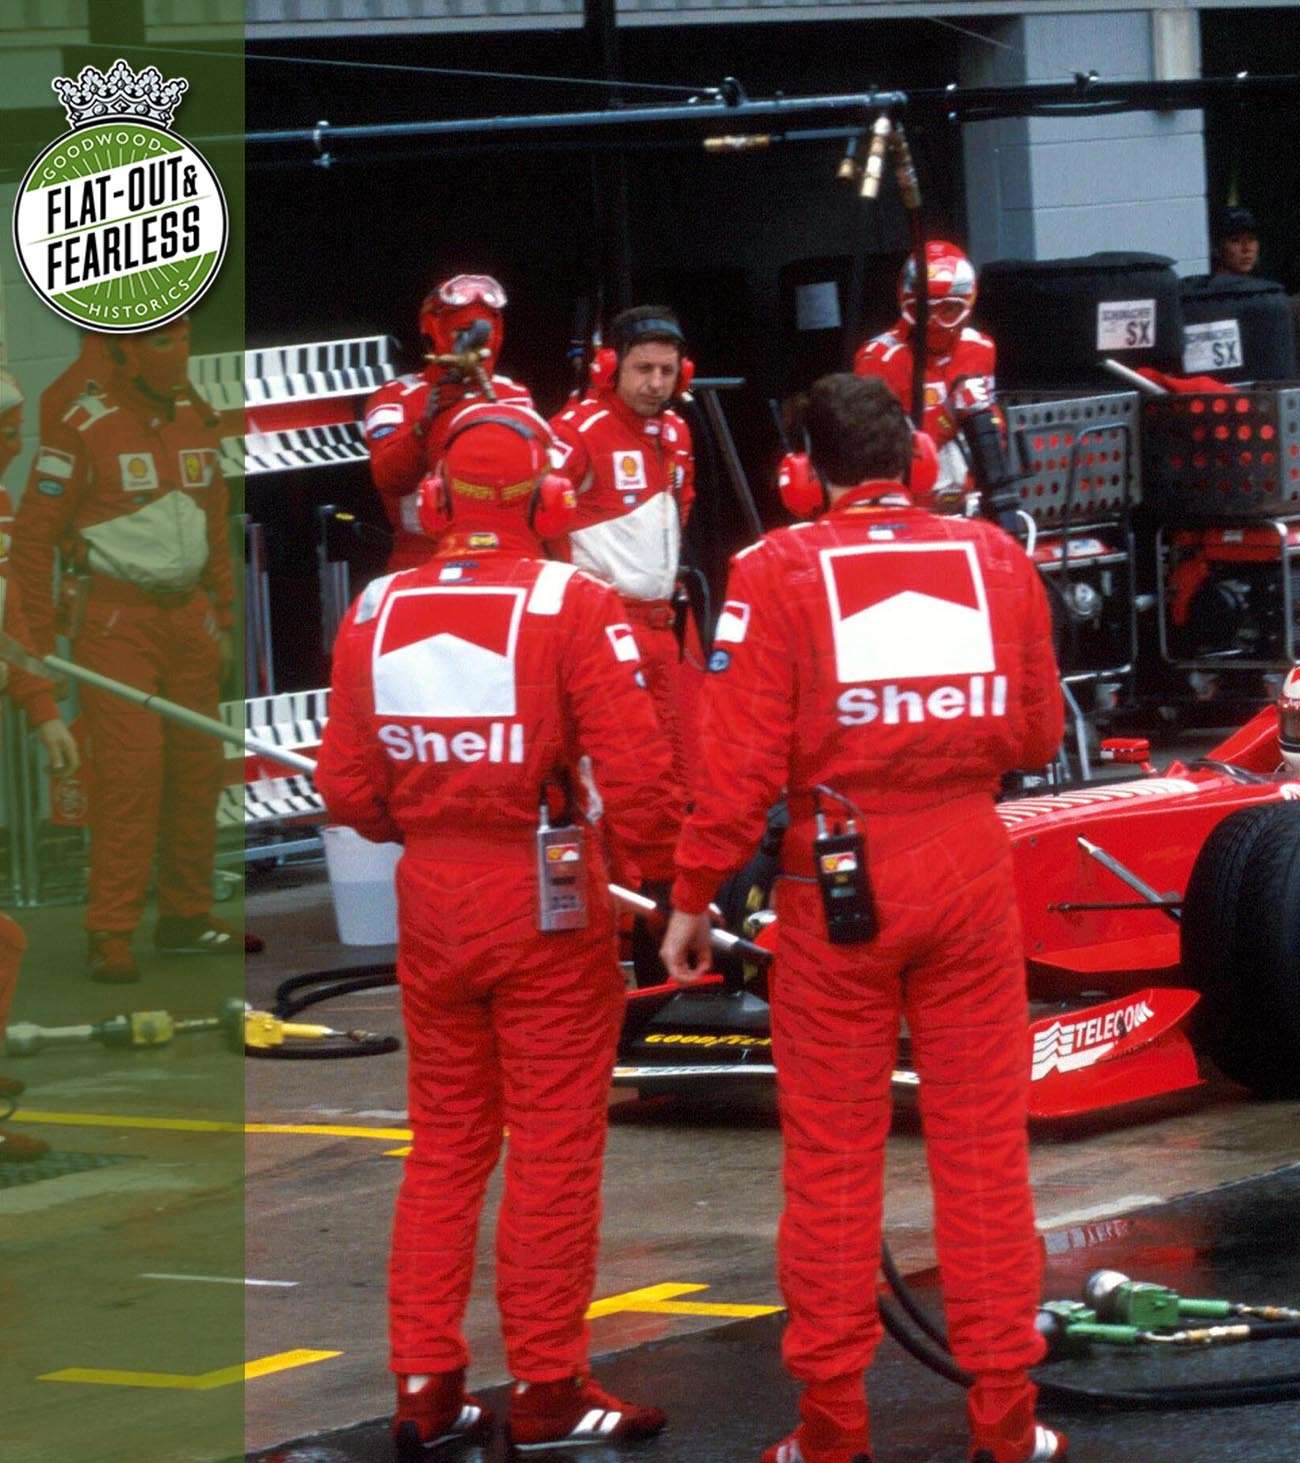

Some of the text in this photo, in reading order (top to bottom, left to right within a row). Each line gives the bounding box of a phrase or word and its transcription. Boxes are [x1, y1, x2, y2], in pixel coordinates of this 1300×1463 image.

[1126, 320, 1151, 347] SX
[1212, 341, 1239, 367] SX
[835, 674, 1008, 727] Shell
[376, 722, 525, 764] Shell
[1074, 1000, 1155, 1049] TELECOM
